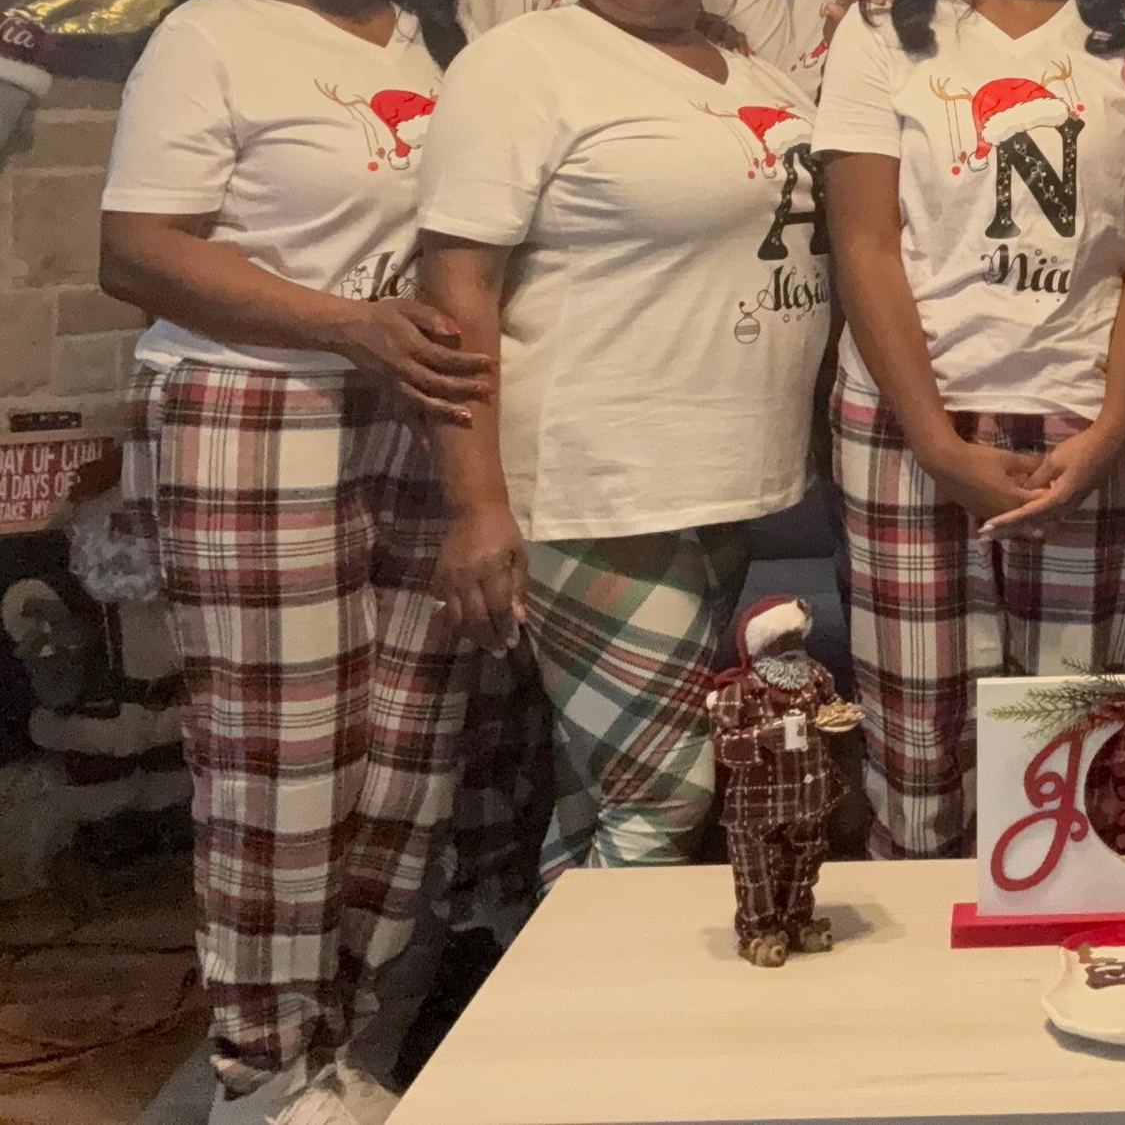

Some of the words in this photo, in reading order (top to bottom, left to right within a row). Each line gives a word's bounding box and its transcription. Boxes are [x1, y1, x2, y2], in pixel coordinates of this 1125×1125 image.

[757, 142, 831, 261] A
[985, 117, 1085, 240] N
[981, 244, 1071, 295] Nia
[11, 474, 50, 501] DAYS
